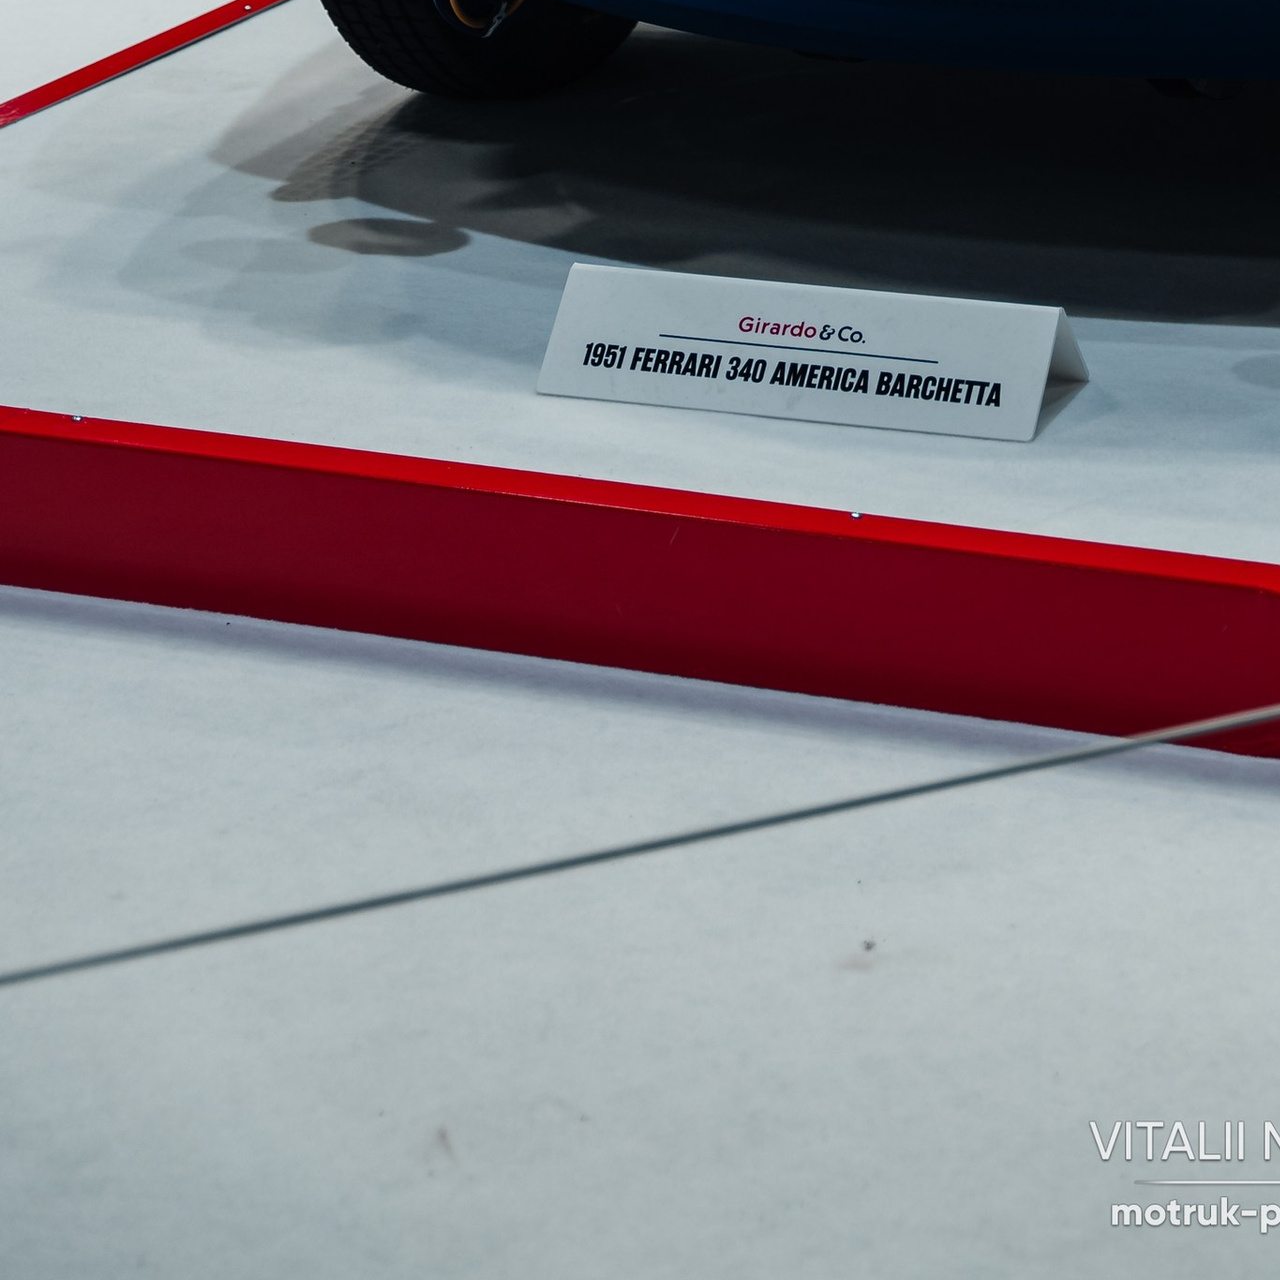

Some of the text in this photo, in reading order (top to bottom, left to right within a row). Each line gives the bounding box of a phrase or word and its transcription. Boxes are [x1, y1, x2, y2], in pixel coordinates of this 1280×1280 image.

[738, 316, 817, 339] Girardo
[582, 342, 1002, 408] 1951 FERRARI 340 AMERICA BARCHETTA
